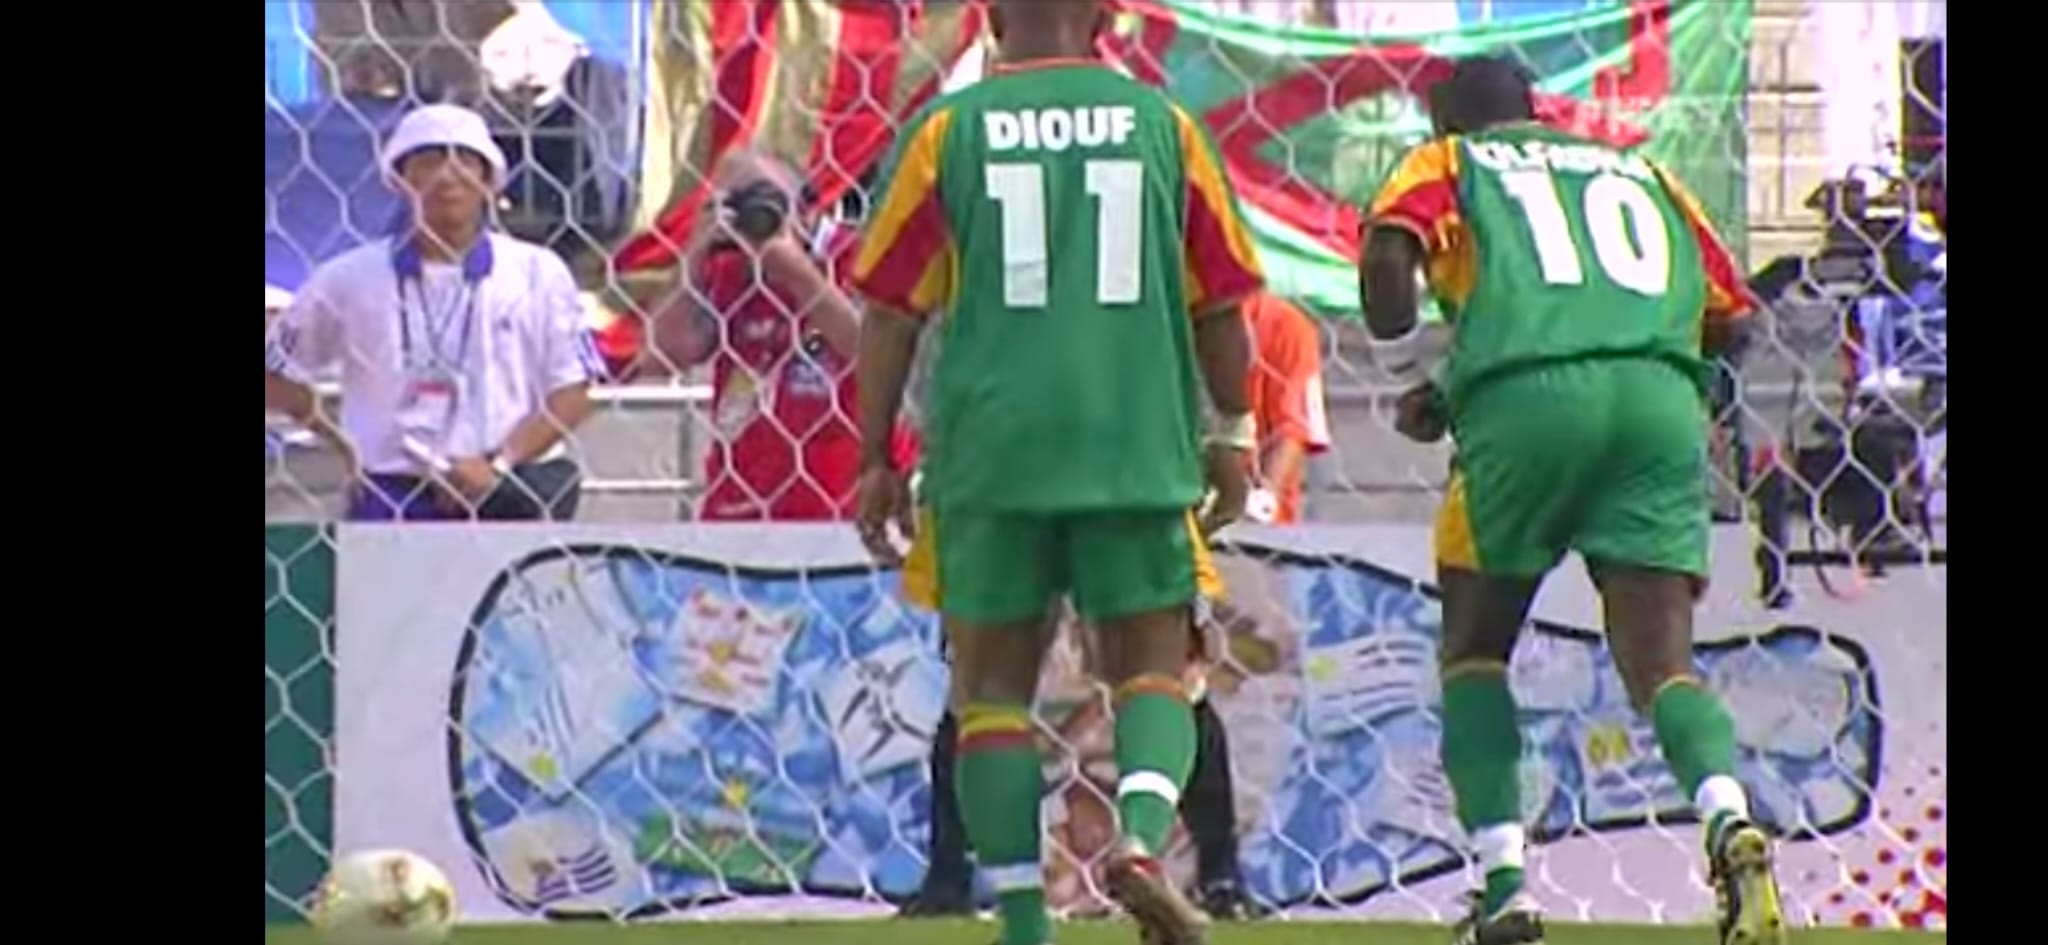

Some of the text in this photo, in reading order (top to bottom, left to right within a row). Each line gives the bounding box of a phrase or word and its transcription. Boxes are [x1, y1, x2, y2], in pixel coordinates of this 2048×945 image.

[984, 107, 1135, 151] DIOUF
[985, 161, 1143, 308] 11
[1500, 168, 1670, 295] 10
